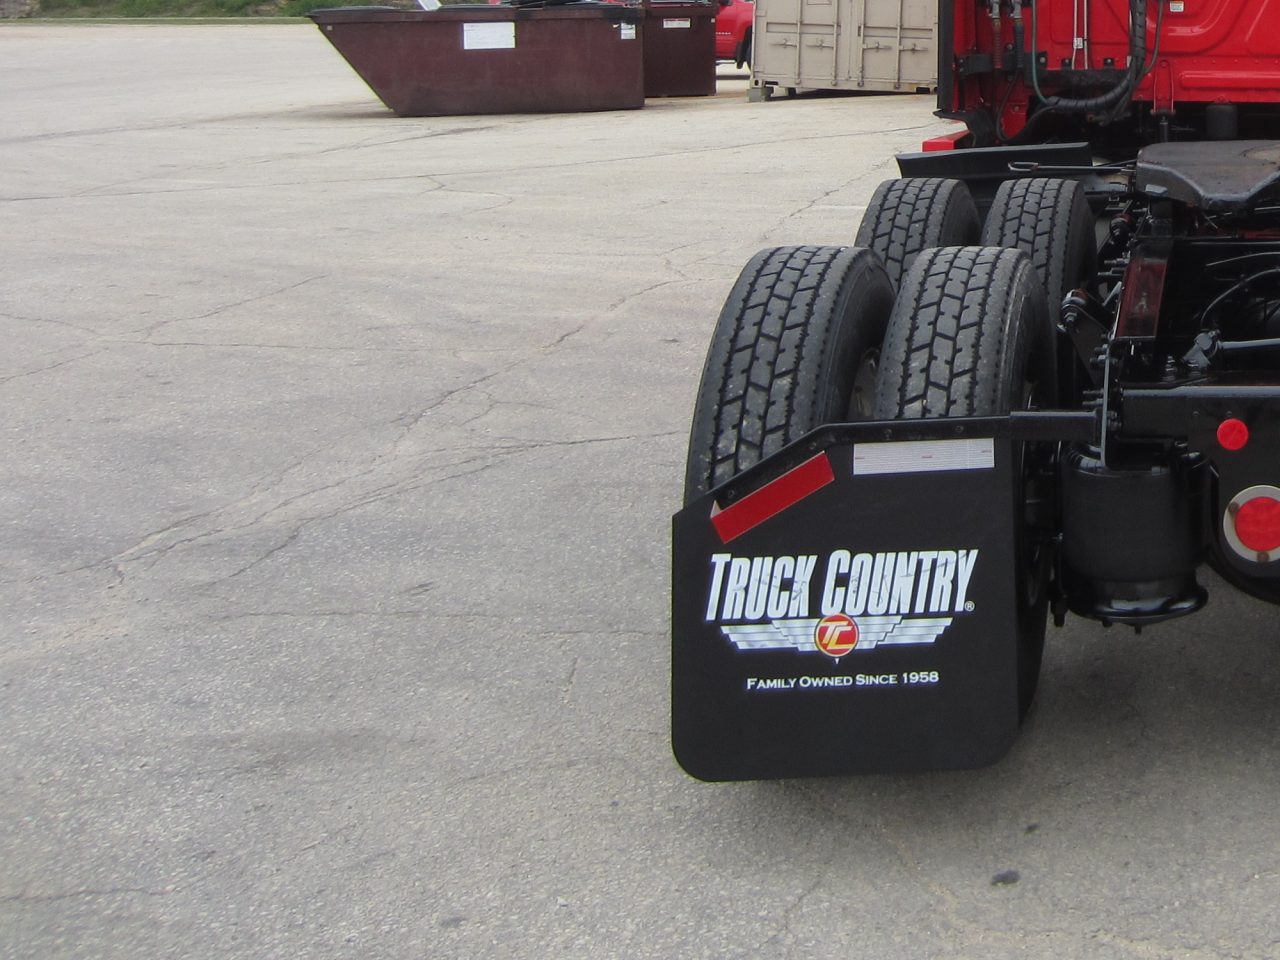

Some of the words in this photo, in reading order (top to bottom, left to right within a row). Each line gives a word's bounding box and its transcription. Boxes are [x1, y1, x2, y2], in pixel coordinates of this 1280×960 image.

[706, 553, 817, 620] TRUCK
[747, 677, 797, 689] FAMILY
[799, 675, 852, 687] OWNED
[855, 673, 898, 685] SINCE
[902, 671, 939, 684] 1958
